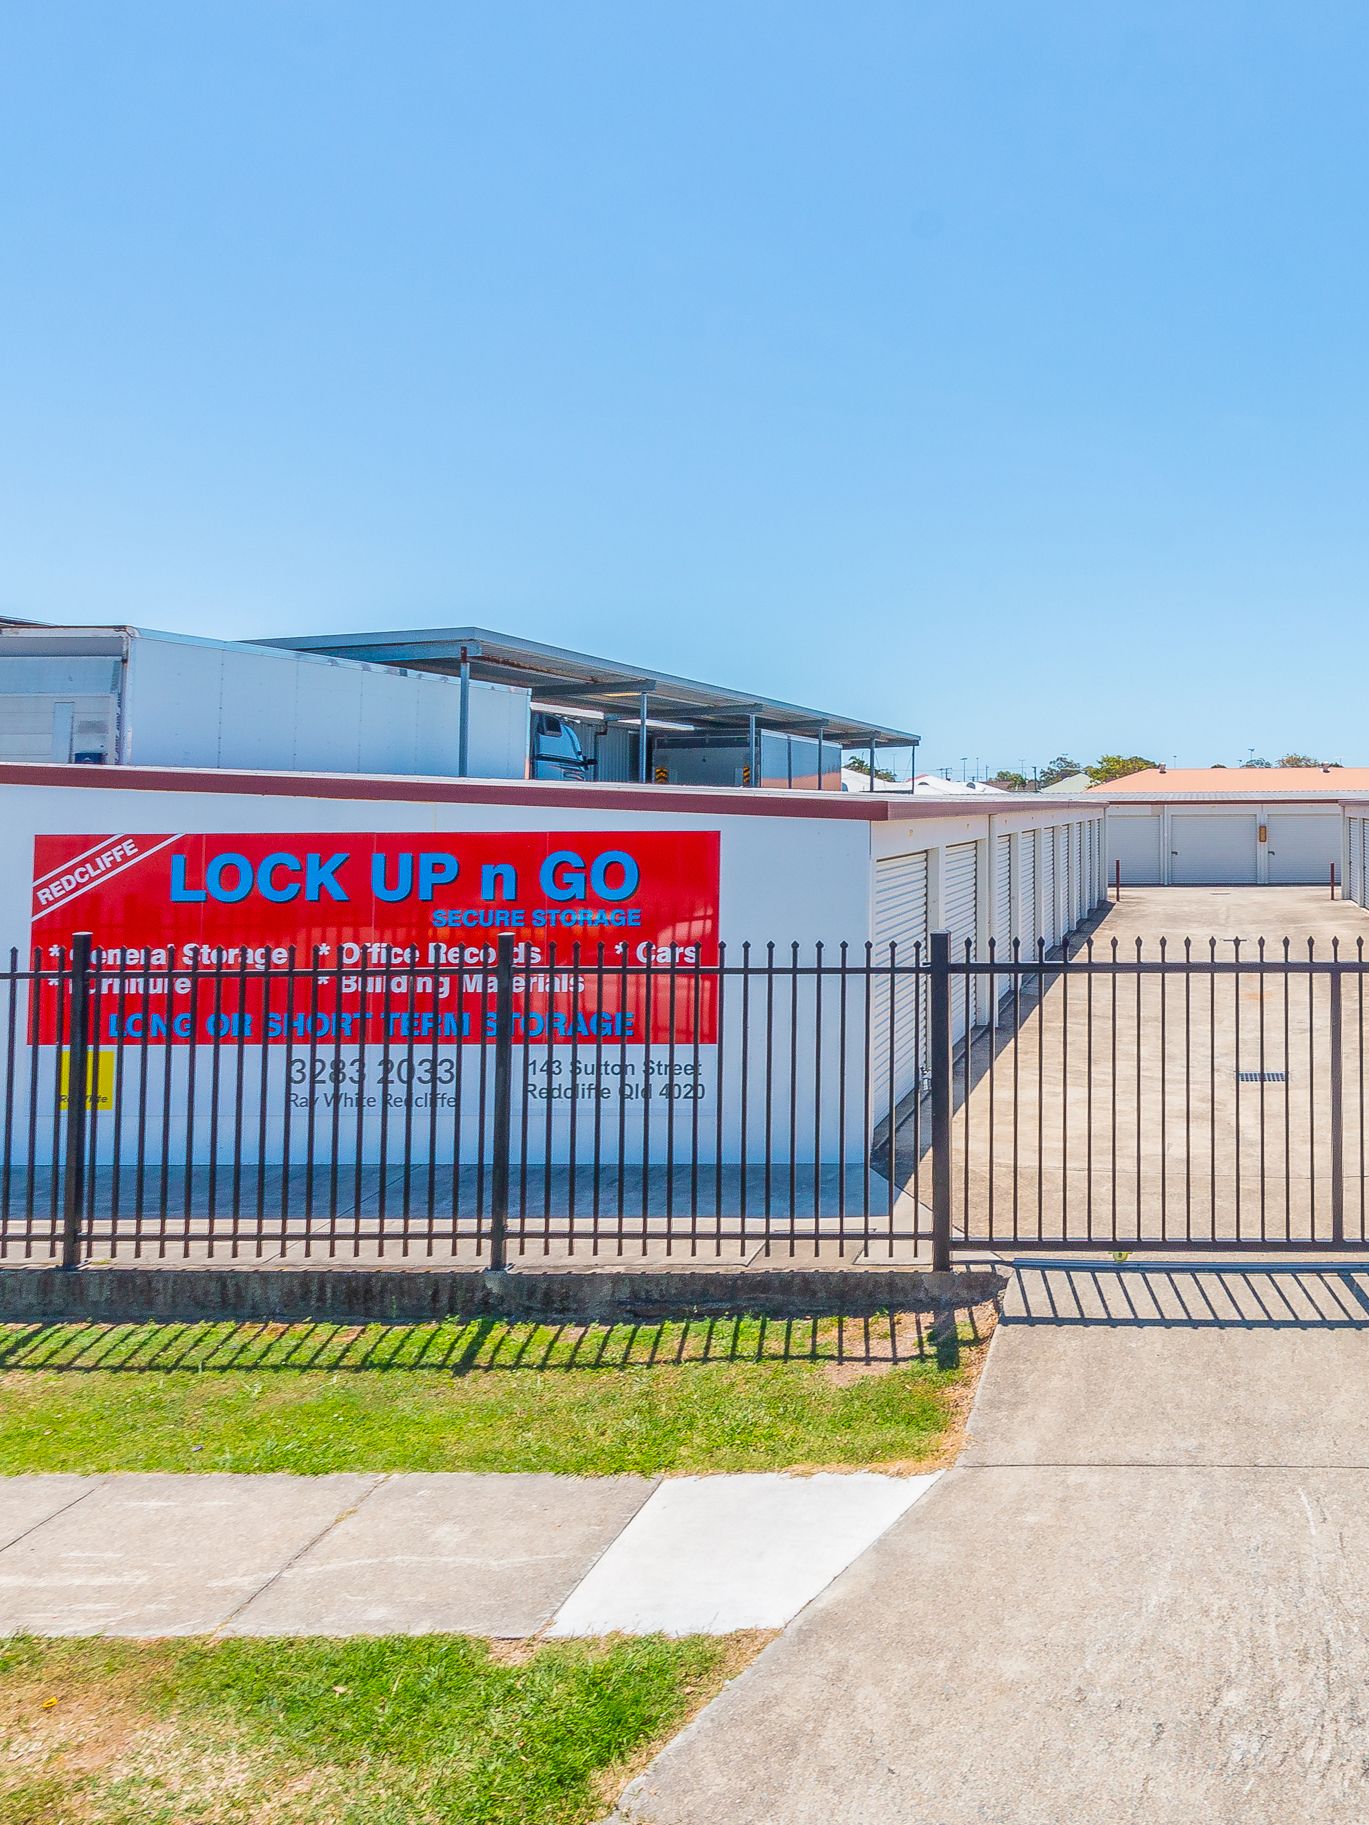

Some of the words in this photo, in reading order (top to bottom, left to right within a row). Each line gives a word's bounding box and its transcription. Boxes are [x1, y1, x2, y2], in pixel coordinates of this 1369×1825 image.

[36, 838, 139, 906] REDCLIFFE
[169, 852, 350, 903] LOCK
[371, 852, 459, 902] UP
[481, 862, 517, 902] n
[539, 850, 640, 902] GO
[432, 909, 526, 928] SECURE
[531, 908, 642, 929] STORAGE
[69, 943, 174, 965] enera
[182, 943, 288, 970] Storage
[428, 941, 541, 964] Recods
[636, 941, 698, 964] Cars
[69, 974, 191, 995] rniture
[341, 972, 450, 999] Buidng
[462, 972, 585, 993] Maerials
[109, 1013, 192, 1037] LONG
[206, 1013, 252, 1037] OR
[381, 1012, 471, 1037] TERM
[289, 1058, 366, 1085] 3283
[376, 1058, 455, 1085] 2033
[528, 1060, 562, 1076] 143
[526, 1083, 611, 1099] Redclife
[618, 1083, 652, 1100] Qld
[658, 1083, 706, 1100] 4020
